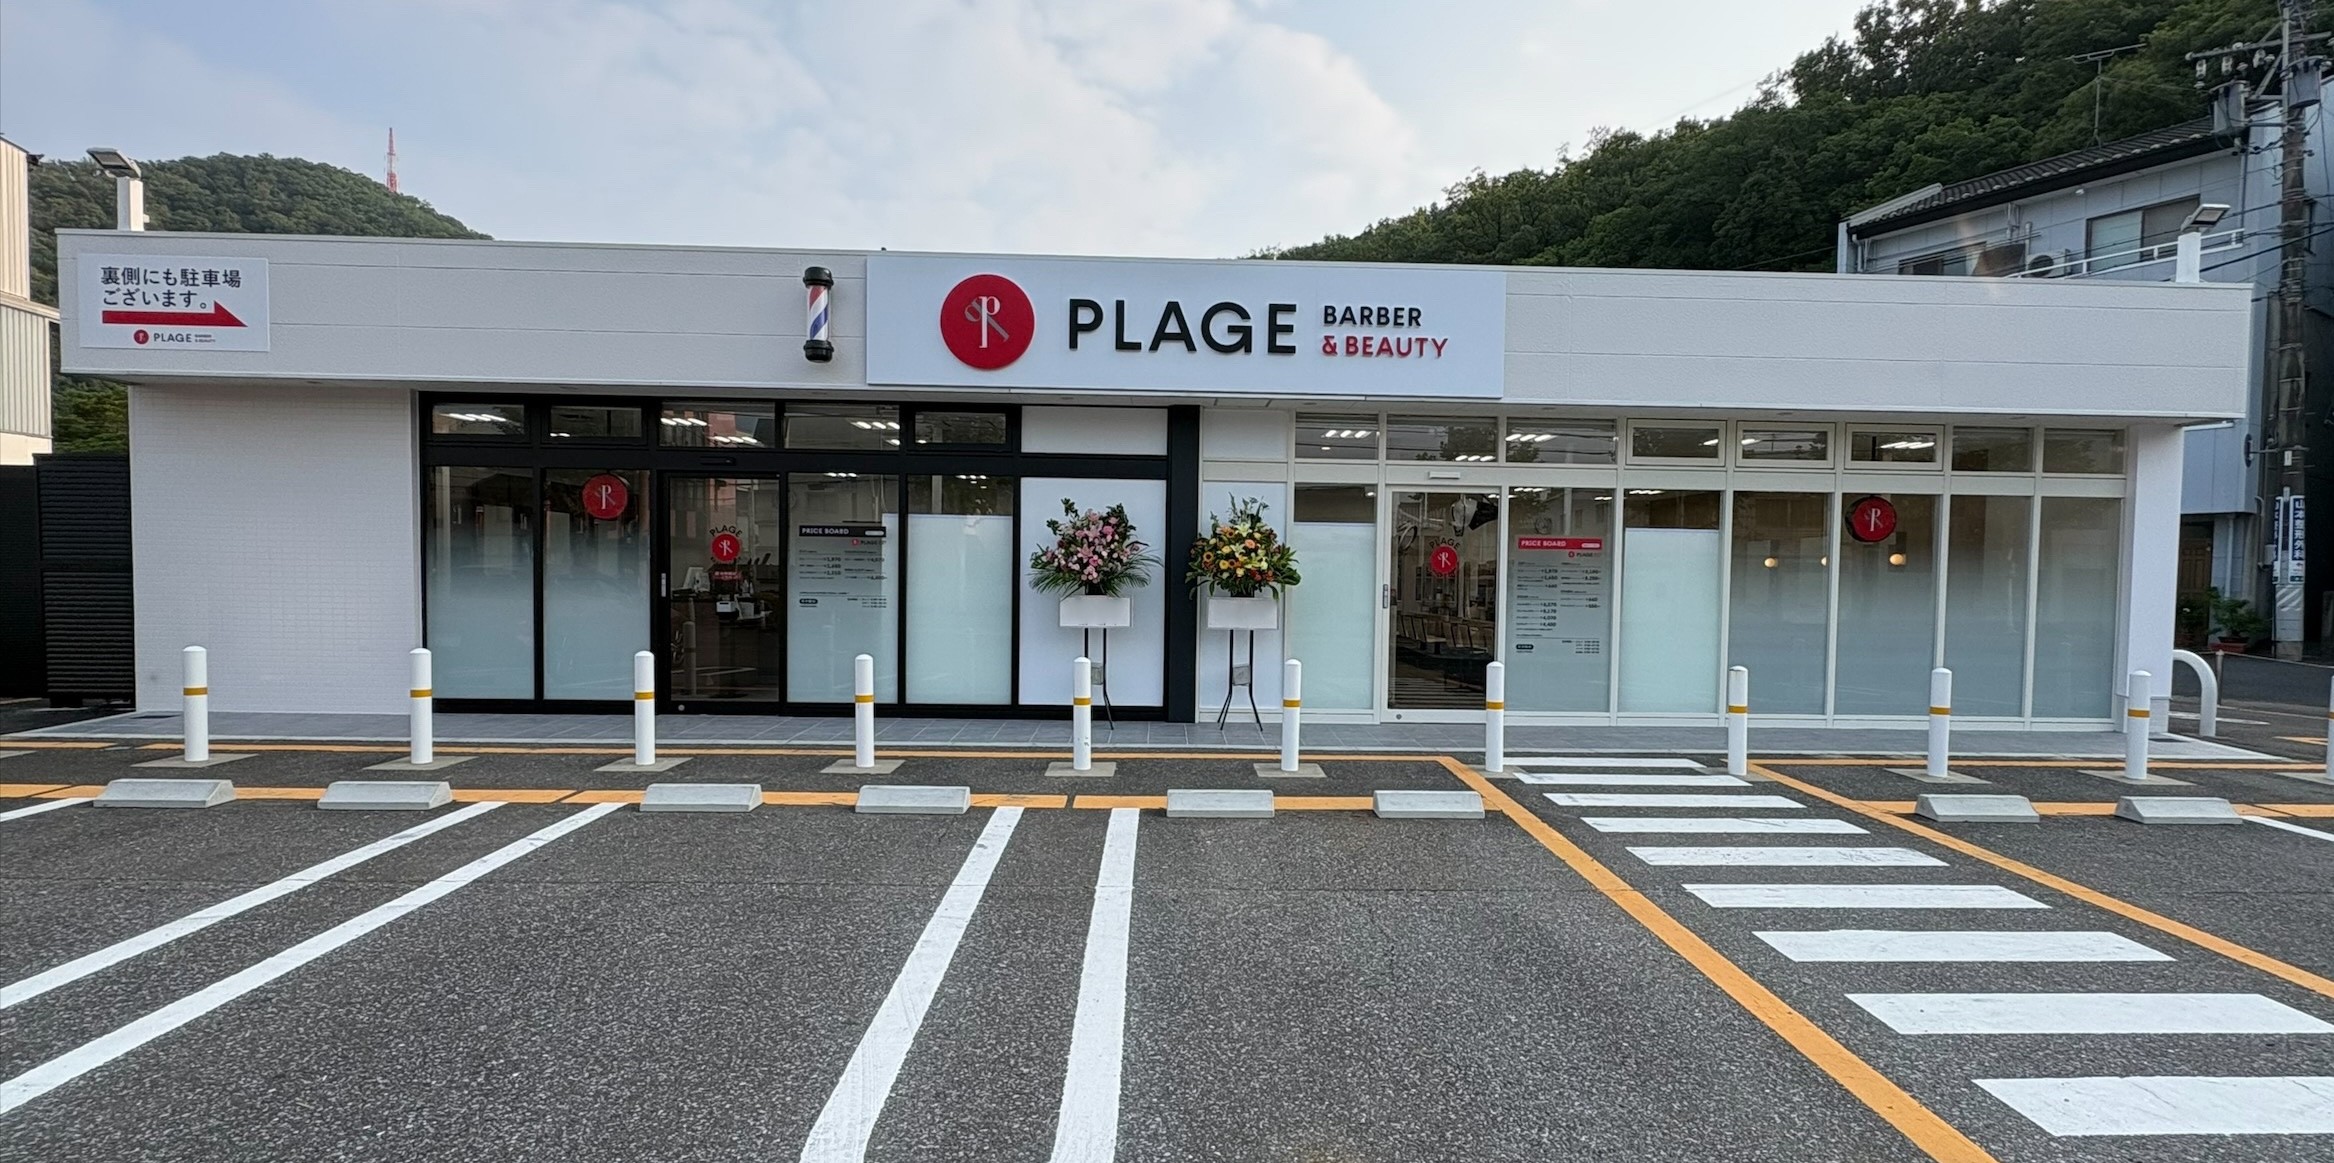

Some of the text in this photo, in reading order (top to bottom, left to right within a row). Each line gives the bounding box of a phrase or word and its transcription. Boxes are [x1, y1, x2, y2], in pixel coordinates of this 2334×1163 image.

[101, 266, 242, 288] 裏側にも駐車場
[103, 287, 207, 309] ございます。
[1069, 298, 1297, 356] PLAGE
[1323, 305, 1422, 327] BARBER
[153, 332, 192, 343] PLAGE
[1321, 335, 1449, 359] & BEAUTY
[709, 525, 743, 537] PLAGE
[824, 527, 850, 535] BOARD
[1429, 537, 1461, 550] PLAGE
